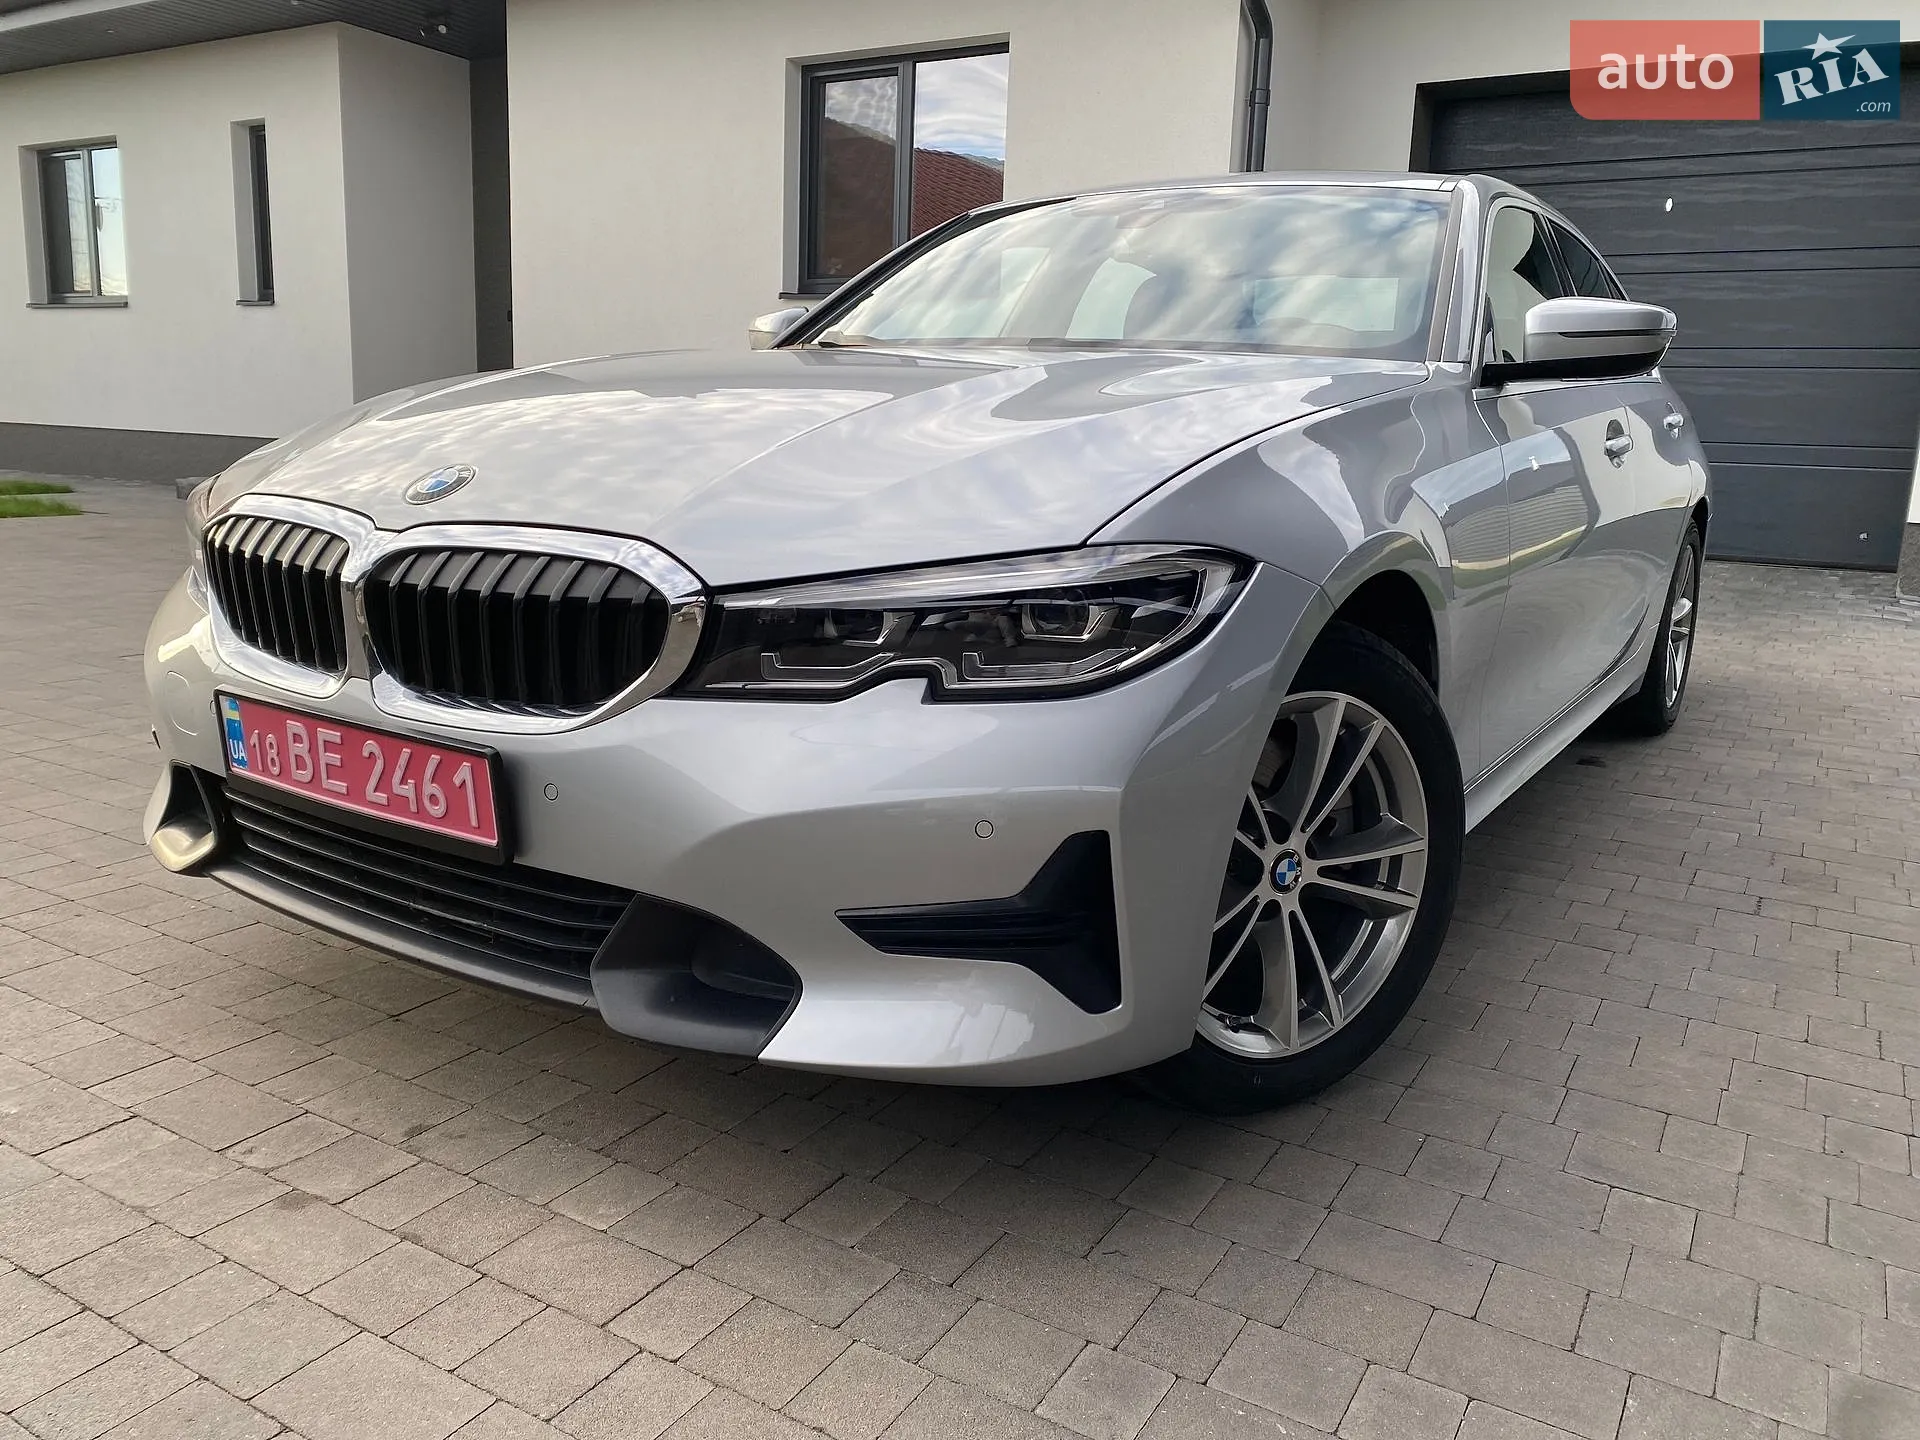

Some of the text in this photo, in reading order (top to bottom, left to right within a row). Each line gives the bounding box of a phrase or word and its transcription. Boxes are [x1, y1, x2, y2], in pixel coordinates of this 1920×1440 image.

[229, 738, 248, 762] UA
[250, 720, 479, 829] 18 BE 2461
